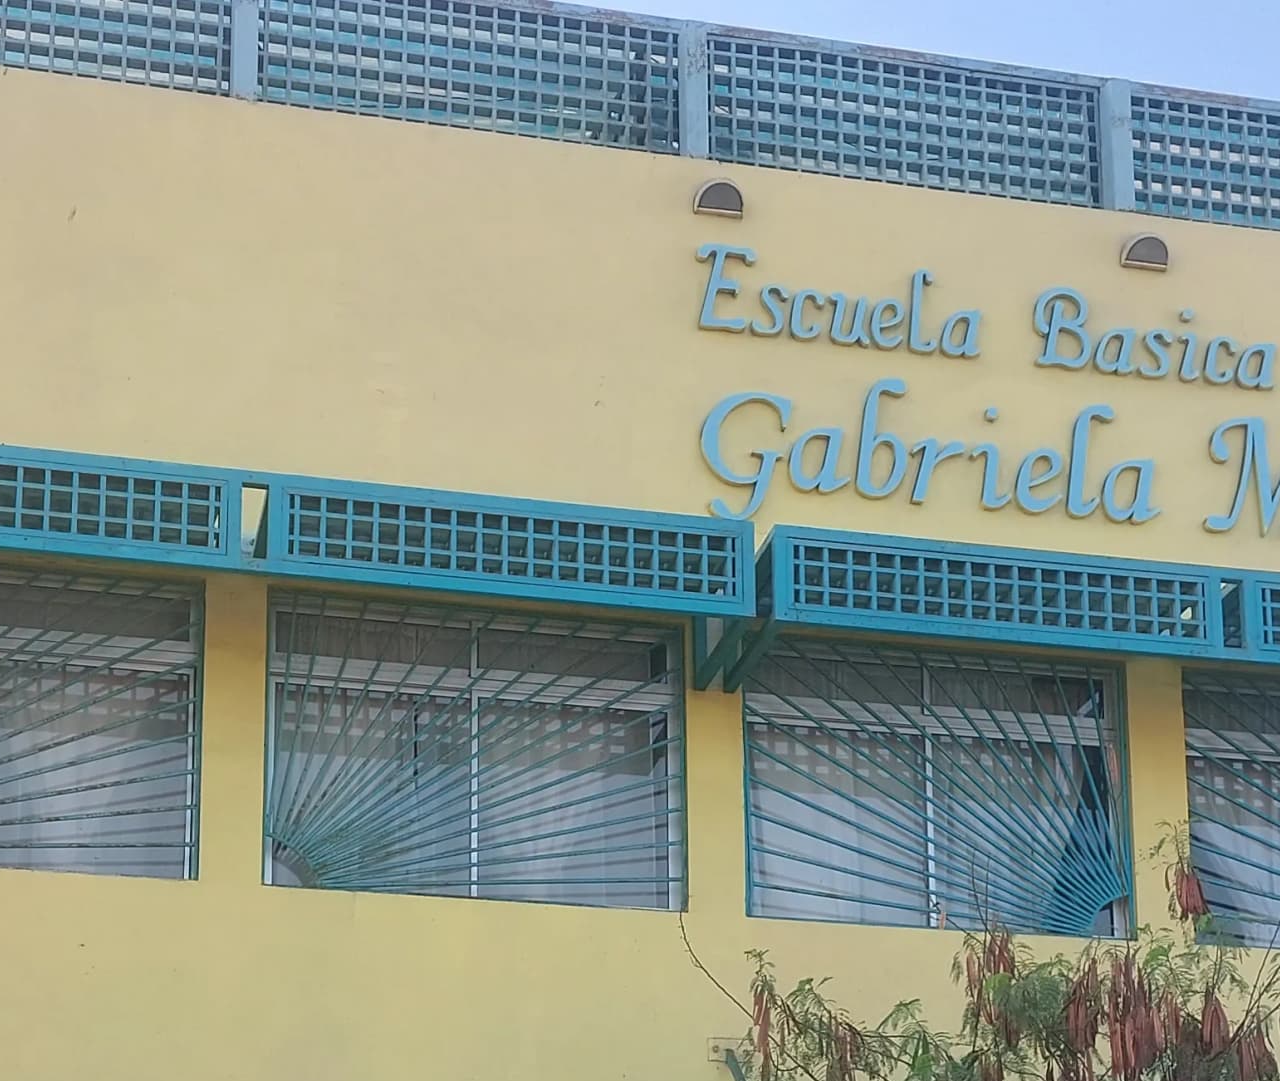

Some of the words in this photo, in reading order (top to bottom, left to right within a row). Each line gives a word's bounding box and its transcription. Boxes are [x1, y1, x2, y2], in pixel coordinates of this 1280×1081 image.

[696, 241, 983, 361] Escuela
[1034, 286, 1278, 393] Basica
[699, 377, 1160, 524] Gabriela
